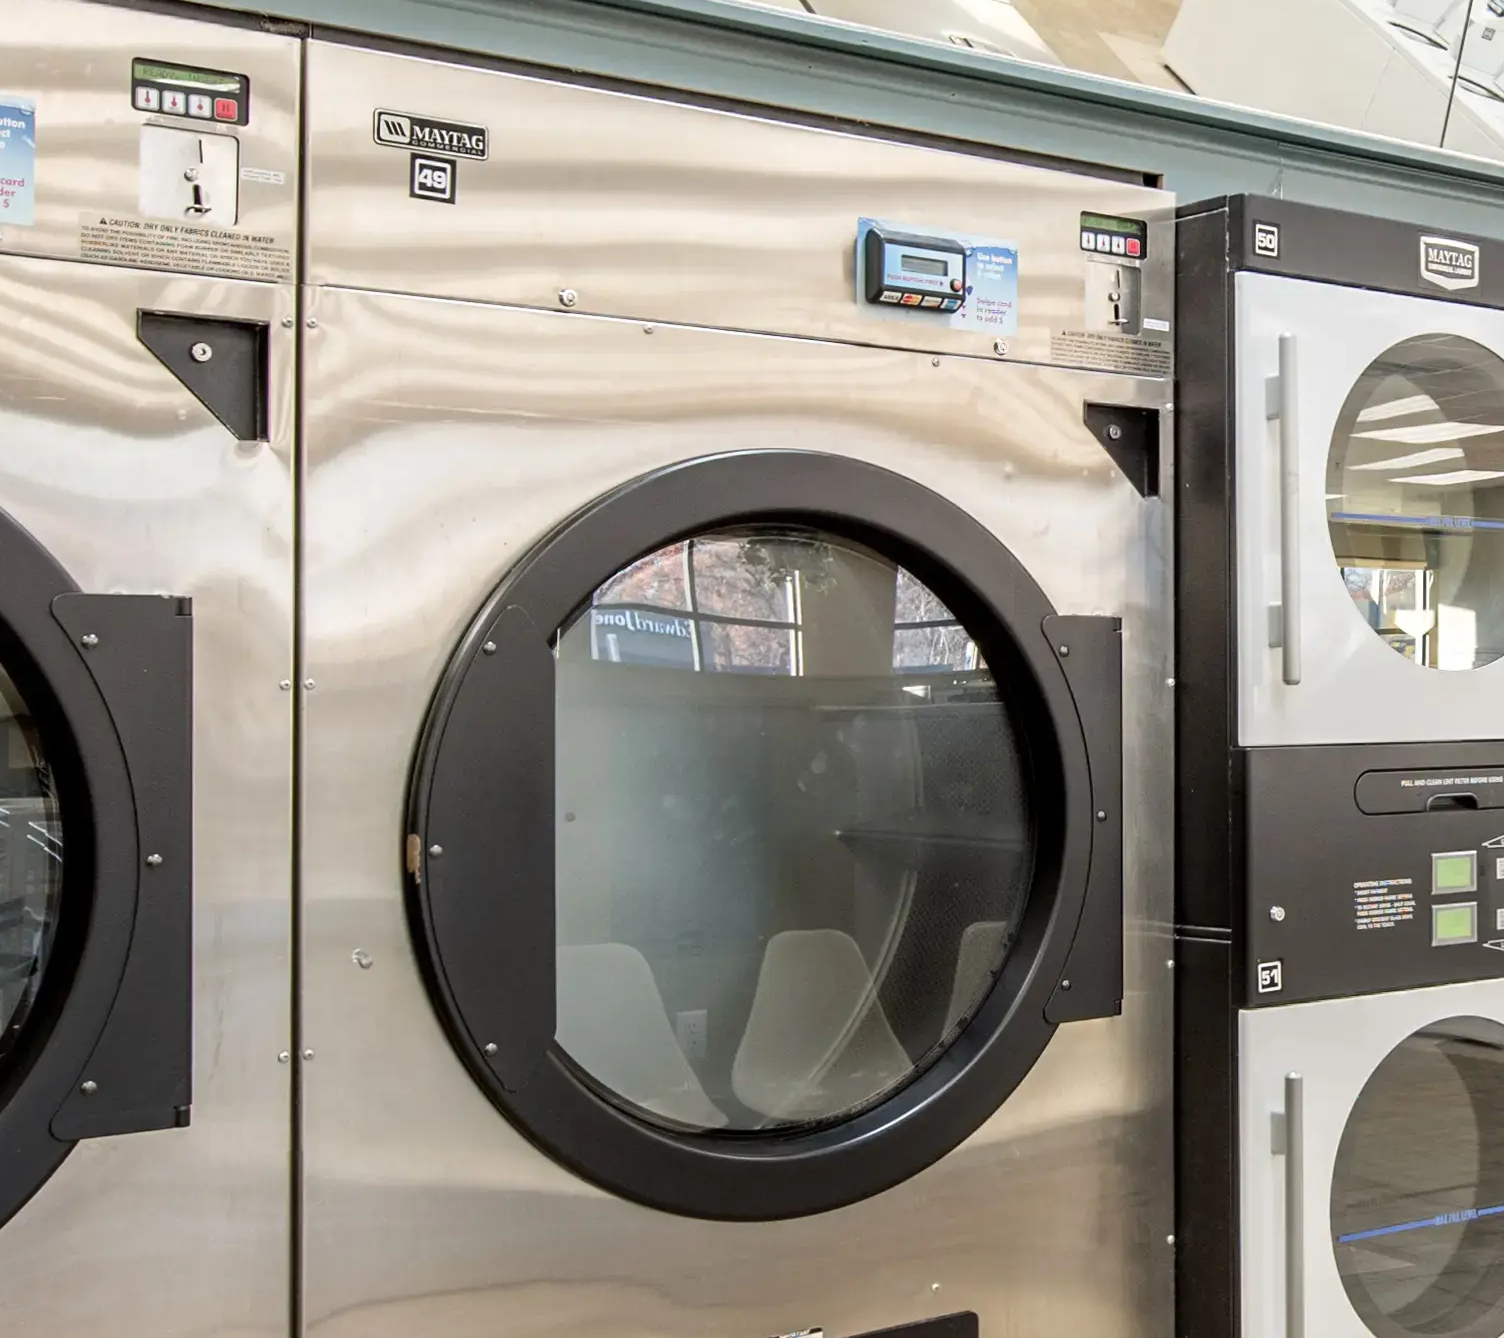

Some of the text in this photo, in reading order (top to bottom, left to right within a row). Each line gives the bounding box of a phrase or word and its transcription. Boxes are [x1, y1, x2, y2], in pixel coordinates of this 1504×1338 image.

[412, 125, 484, 150] MAYTAG
[411, 140, 483, 155] COMMERCIAL
[0, 177, 25, 187] card
[418, 168, 447, 189] 49
[1257, 232, 1275, 248] 50
[1428, 248, 1473, 269] MAYTAG
[1261, 969, 1279, 985] 51
